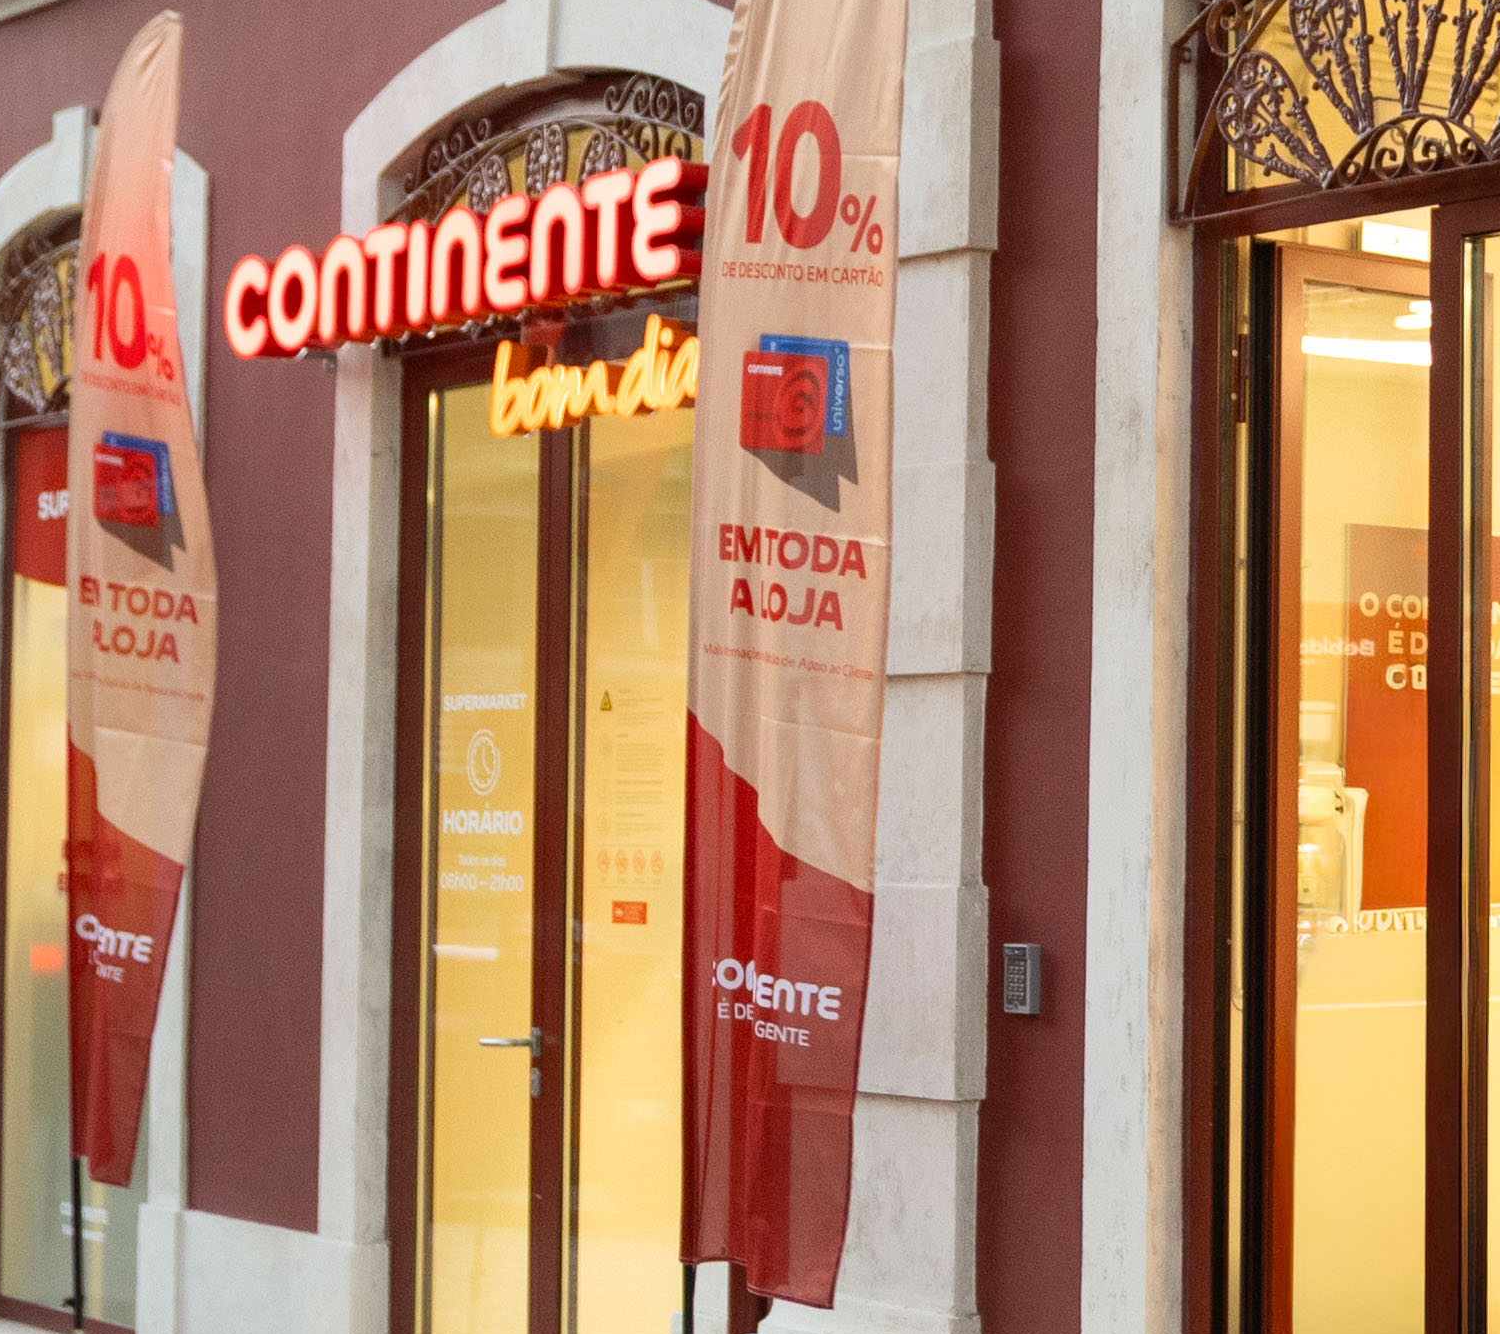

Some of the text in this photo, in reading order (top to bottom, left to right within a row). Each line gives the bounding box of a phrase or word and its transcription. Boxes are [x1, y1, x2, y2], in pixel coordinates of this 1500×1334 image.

[731, 99, 884, 256] 10%
[224, 155, 684, 359] CONTINENTE
[721, 260, 884, 287] DE DESCONTO EM CARTÃO
[86, 251, 175, 382] 10%
[488, 314, 700, 438] bom dia
[719, 522, 868, 581] EM TODA
[106, 581, 199, 627] TODA
[729, 577, 755, 617] A
[1359, 591, 1380, 617] O
[1387, 621, 1405, 655] É
[442, 693, 528, 712] SUPERMARKET
[442, 802, 524, 835] HORÁRIO
[754, 1019, 811, 1048] GENTE
